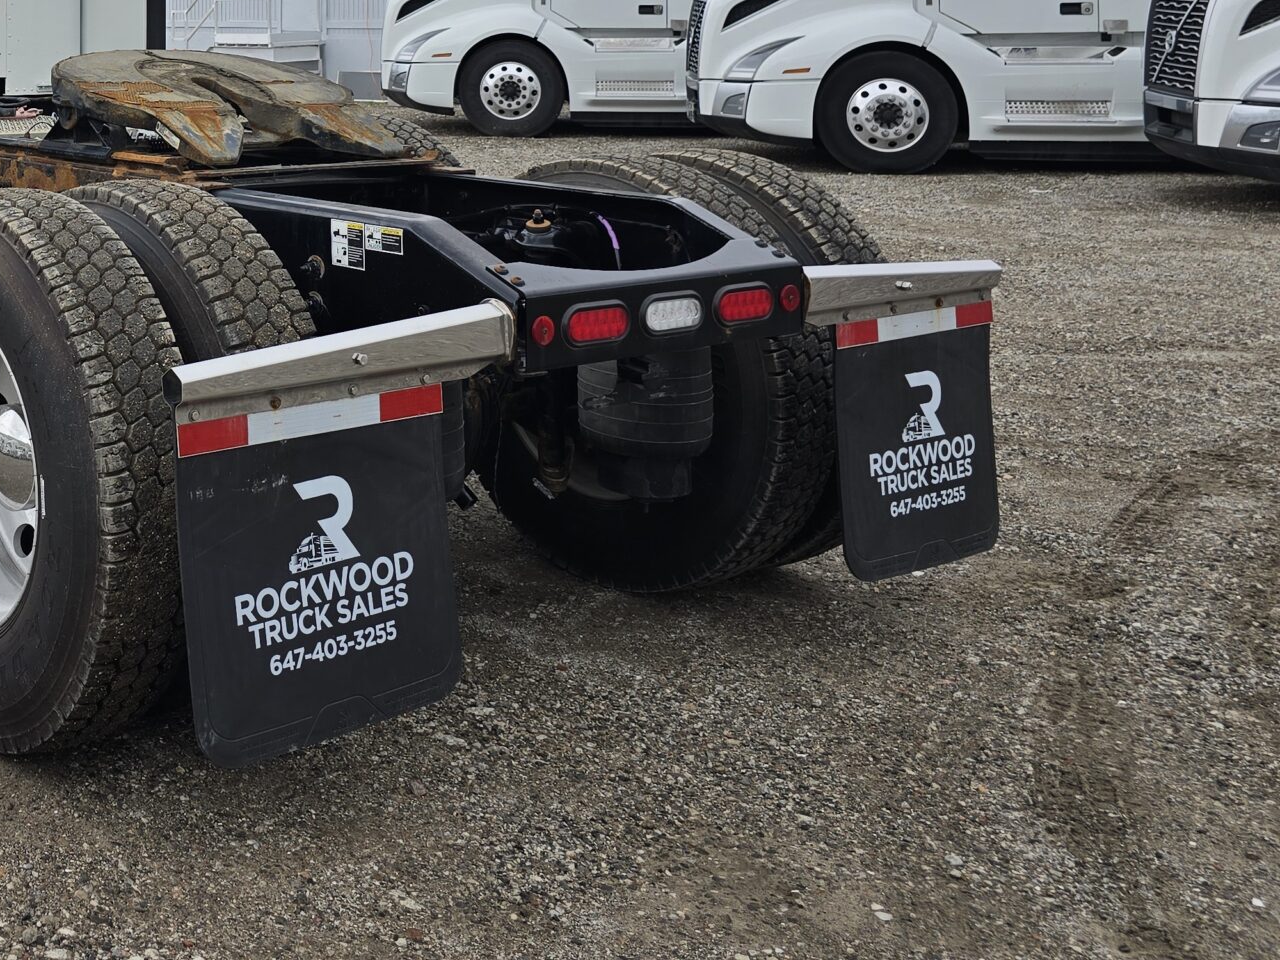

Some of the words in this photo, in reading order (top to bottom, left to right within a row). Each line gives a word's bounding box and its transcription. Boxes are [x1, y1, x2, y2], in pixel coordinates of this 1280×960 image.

[904, 369, 946, 437] R
[869, 433, 976, 478] ROCKWOOD
[877, 467, 929, 497] TRUCK
[931, 457, 973, 486] SALES
[292, 474, 361, 560] R
[889, 485, 967, 518] 647-403-3255
[234, 551, 414, 627] ROCKWOOD
[248, 607, 333, 650] TRUCK
[337, 583, 409, 621] SALES
[269, 620, 398, 677] 647-403-3255
